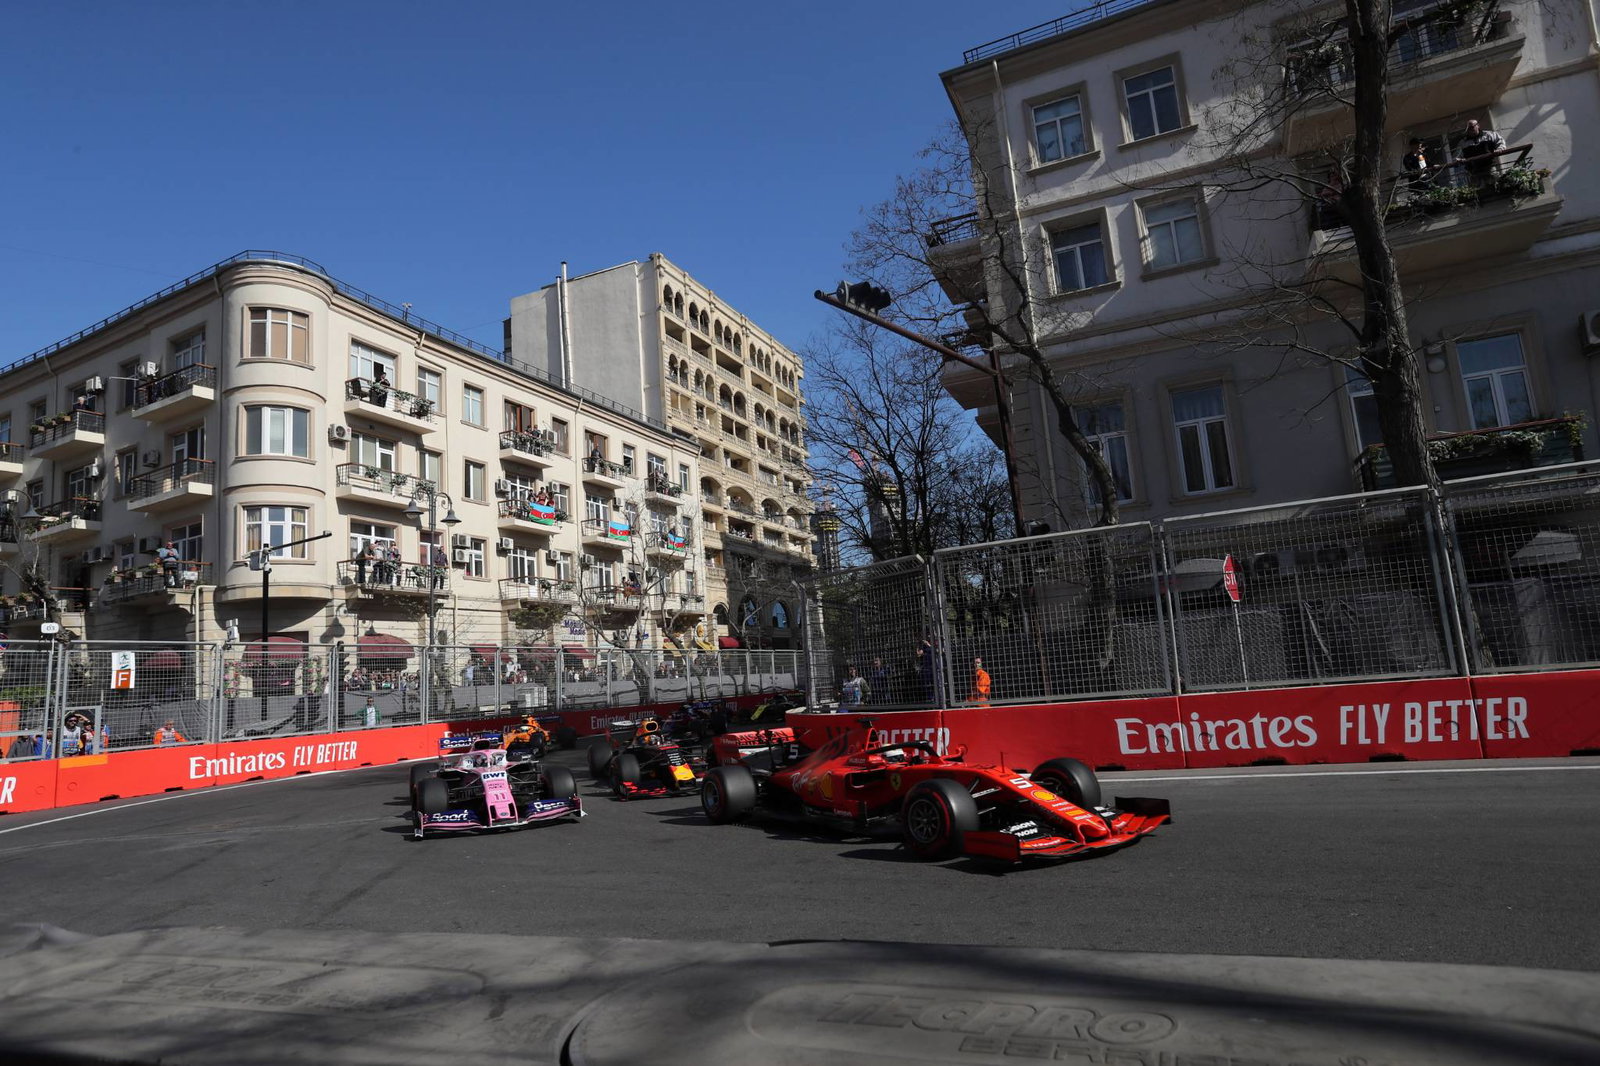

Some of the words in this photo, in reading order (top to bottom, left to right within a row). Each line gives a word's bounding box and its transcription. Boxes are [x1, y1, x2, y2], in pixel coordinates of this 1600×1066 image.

[118, 672, 129, 686] F
[1114, 711, 1318, 755] Emirates
[1339, 703, 1391, 746] FLY
[1404, 696, 1530, 743] BETTER
[788, 744, 799, 759] 5
[189, 751, 286, 780] Emirates
[293, 745, 315, 767] FLY
[316, 741, 358, 764] BETTER
[483, 772, 505, 780] BWT
[1009, 777, 1033, 789] 5
[0, 776, 17, 804] R
[494, 792, 505, 801] 11
[431, 809, 469, 822] Sport
